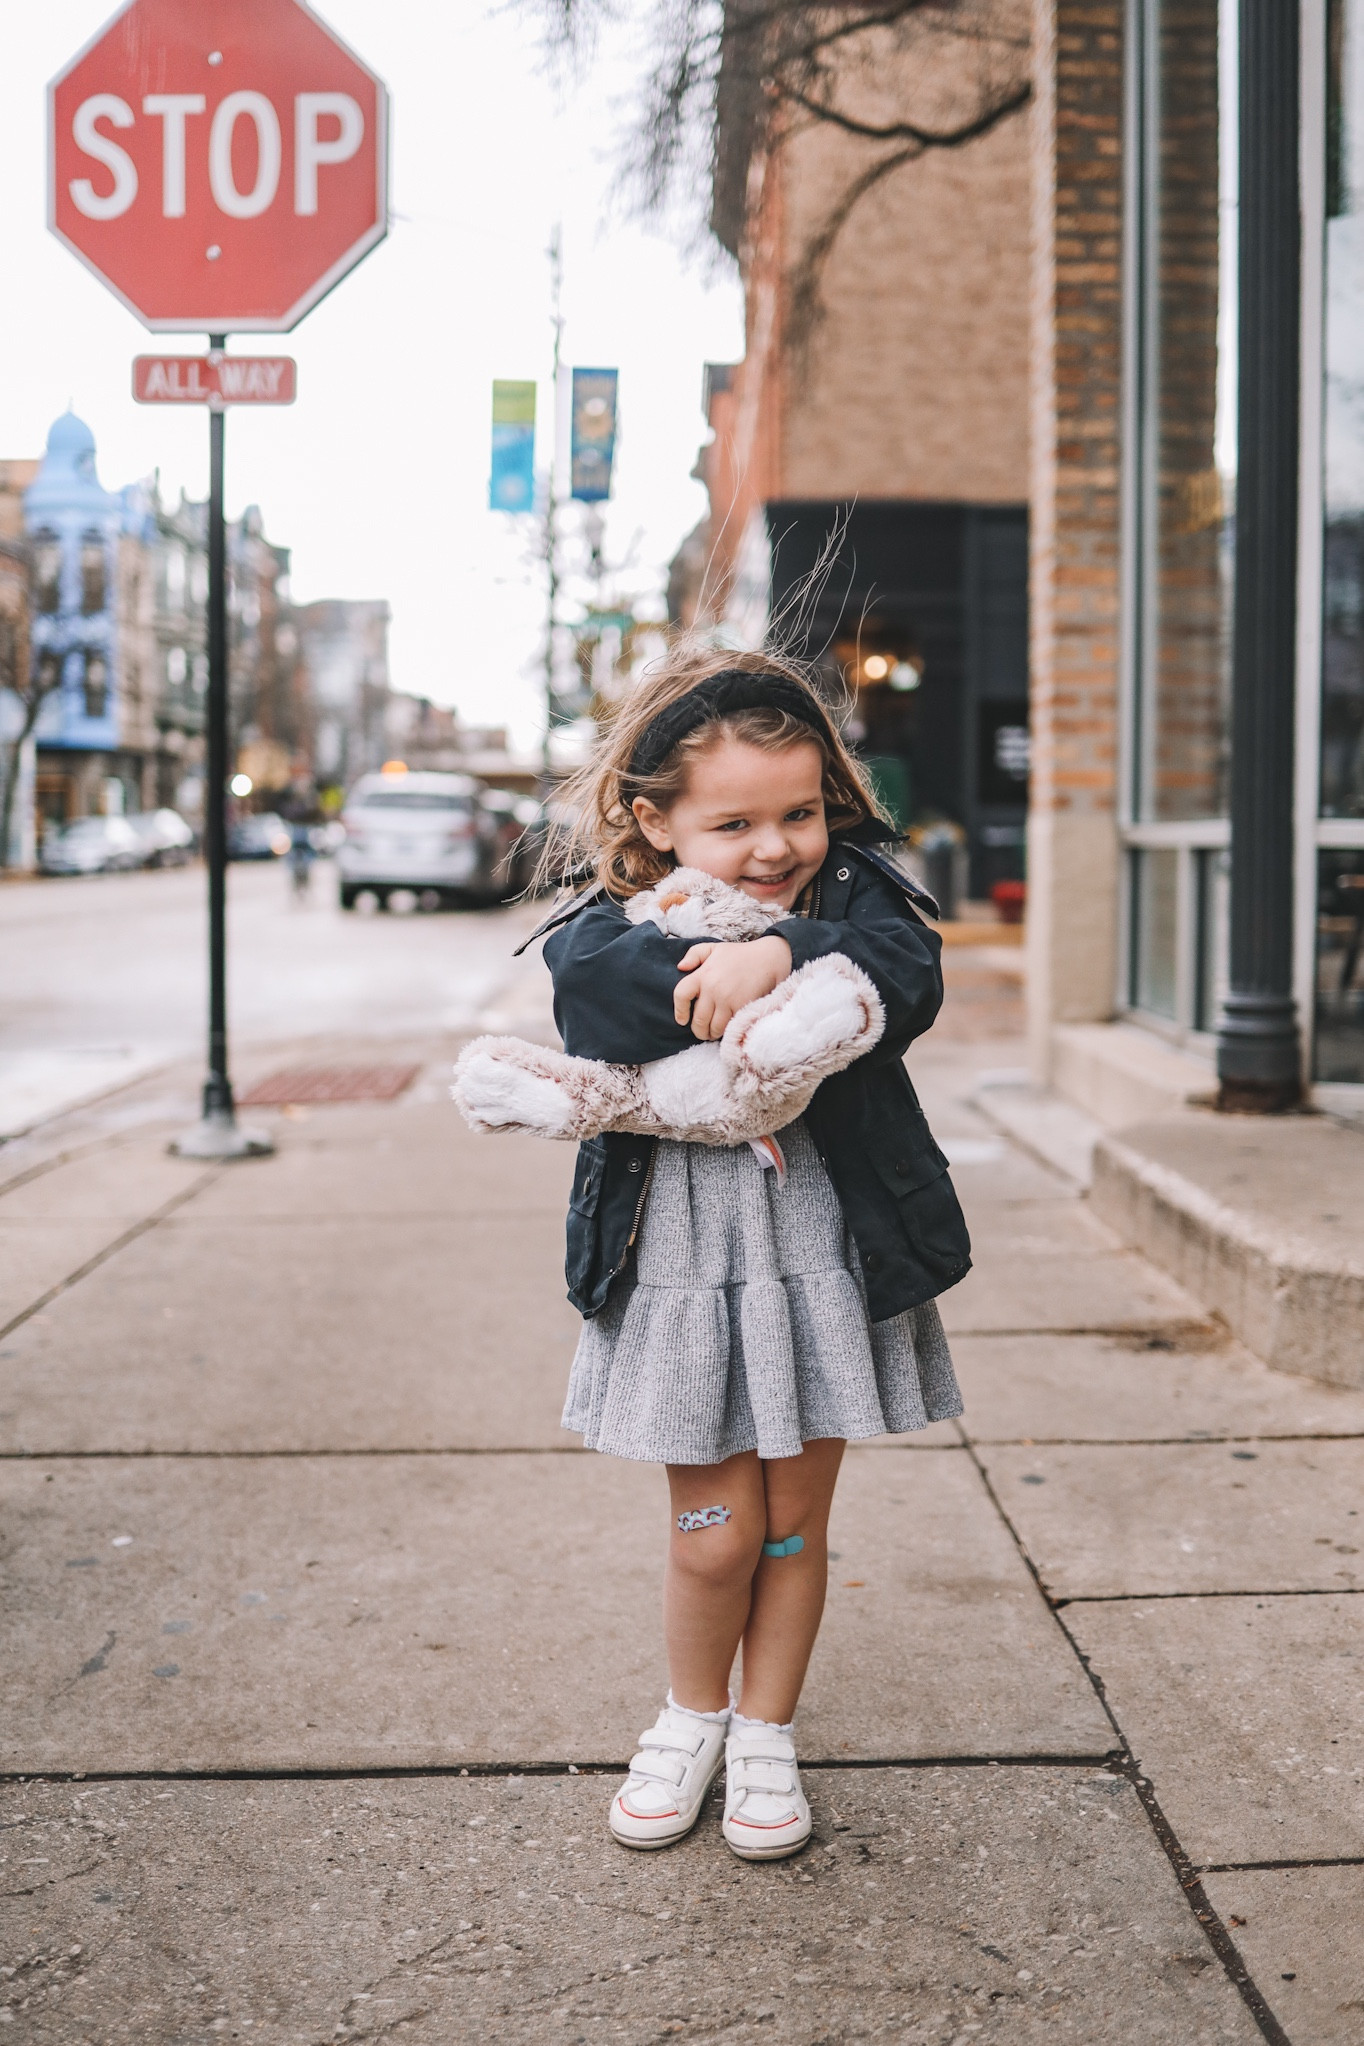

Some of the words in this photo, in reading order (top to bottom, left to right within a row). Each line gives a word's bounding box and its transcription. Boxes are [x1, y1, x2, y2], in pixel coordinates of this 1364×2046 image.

[69, 90, 364, 220] STOP
[145, 362, 209, 398] ALL
[217, 362, 284, 397] WAY
